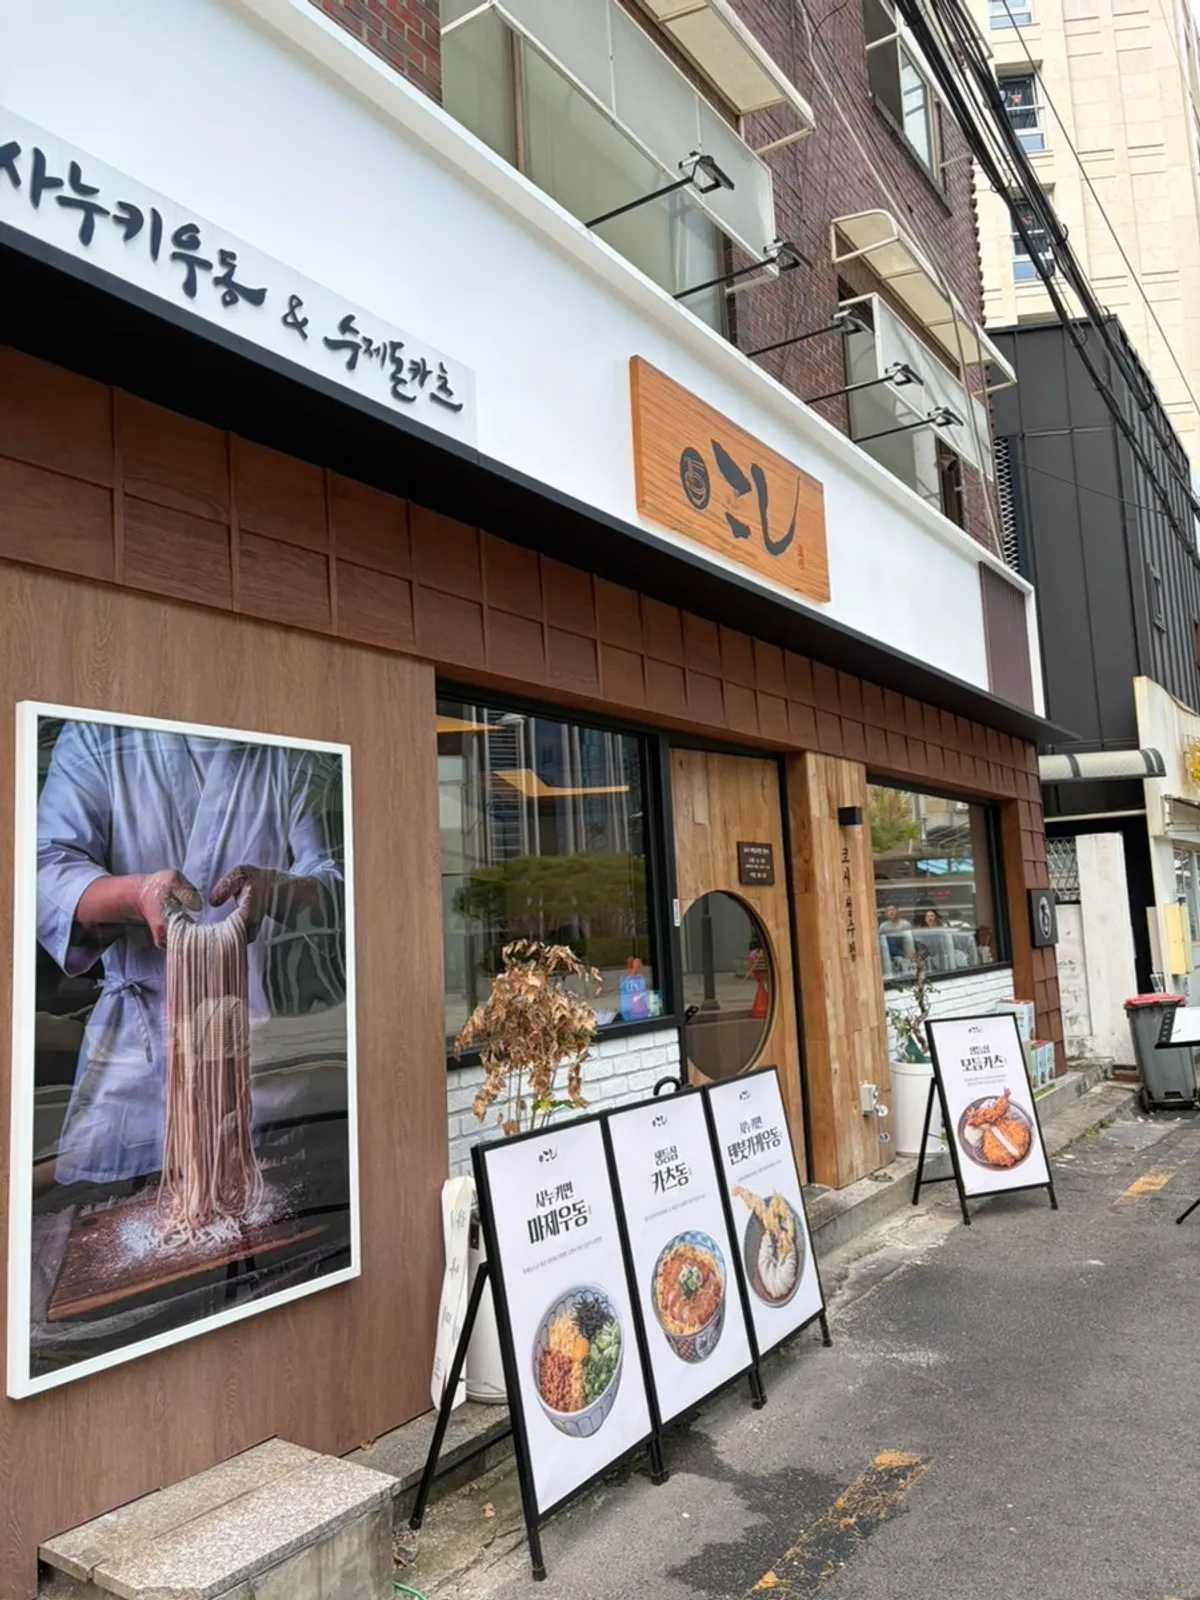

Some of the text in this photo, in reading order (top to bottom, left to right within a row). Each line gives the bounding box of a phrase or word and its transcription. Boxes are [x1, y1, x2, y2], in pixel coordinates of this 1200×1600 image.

[0, 141, 463, 413] 사누키우동 & 수제돈카츠
[535, 1181, 574, 1208] 사누키면
[651, 1162, 690, 1195] 카츠동
[527, 1199, 588, 1244] 마제우동
